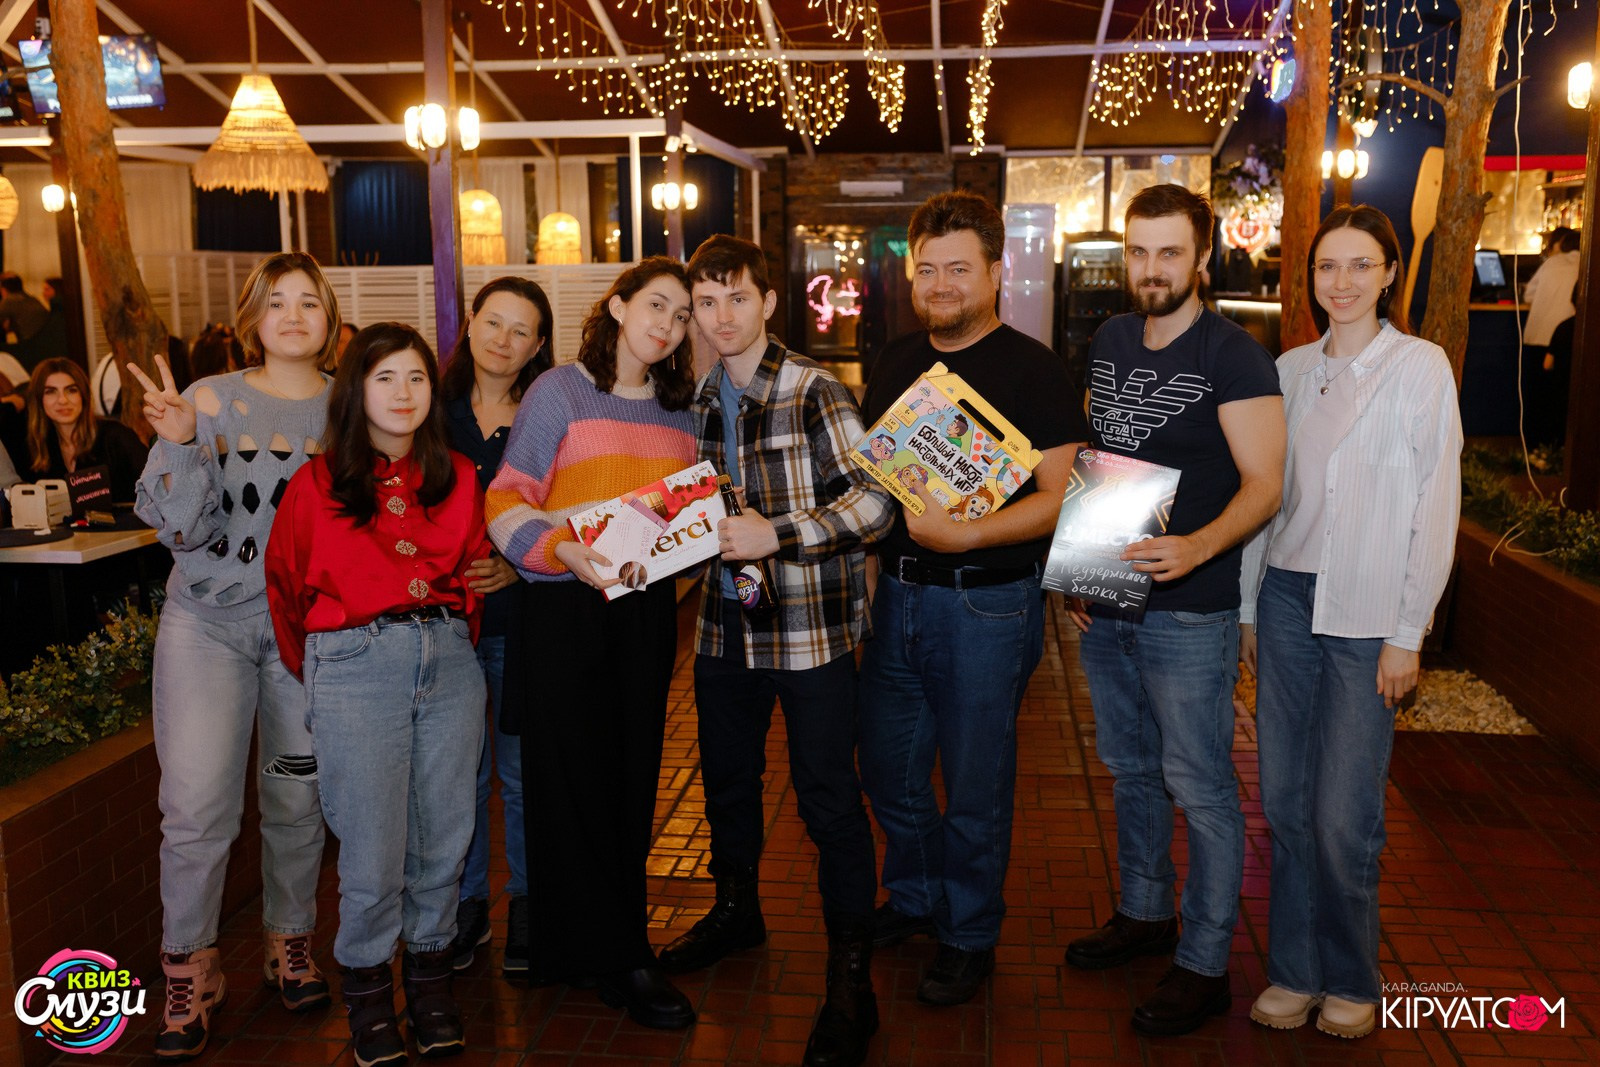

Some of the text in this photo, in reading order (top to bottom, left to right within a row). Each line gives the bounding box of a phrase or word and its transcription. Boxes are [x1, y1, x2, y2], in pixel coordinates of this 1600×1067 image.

[908, 437, 957, 482] НАСТОЛЬНЫХ
[954, 477, 975, 493] ИГР
[917, 425, 983, 485] БОЛЬШОЙ НАБОР
[650, 512, 713, 558] erci
